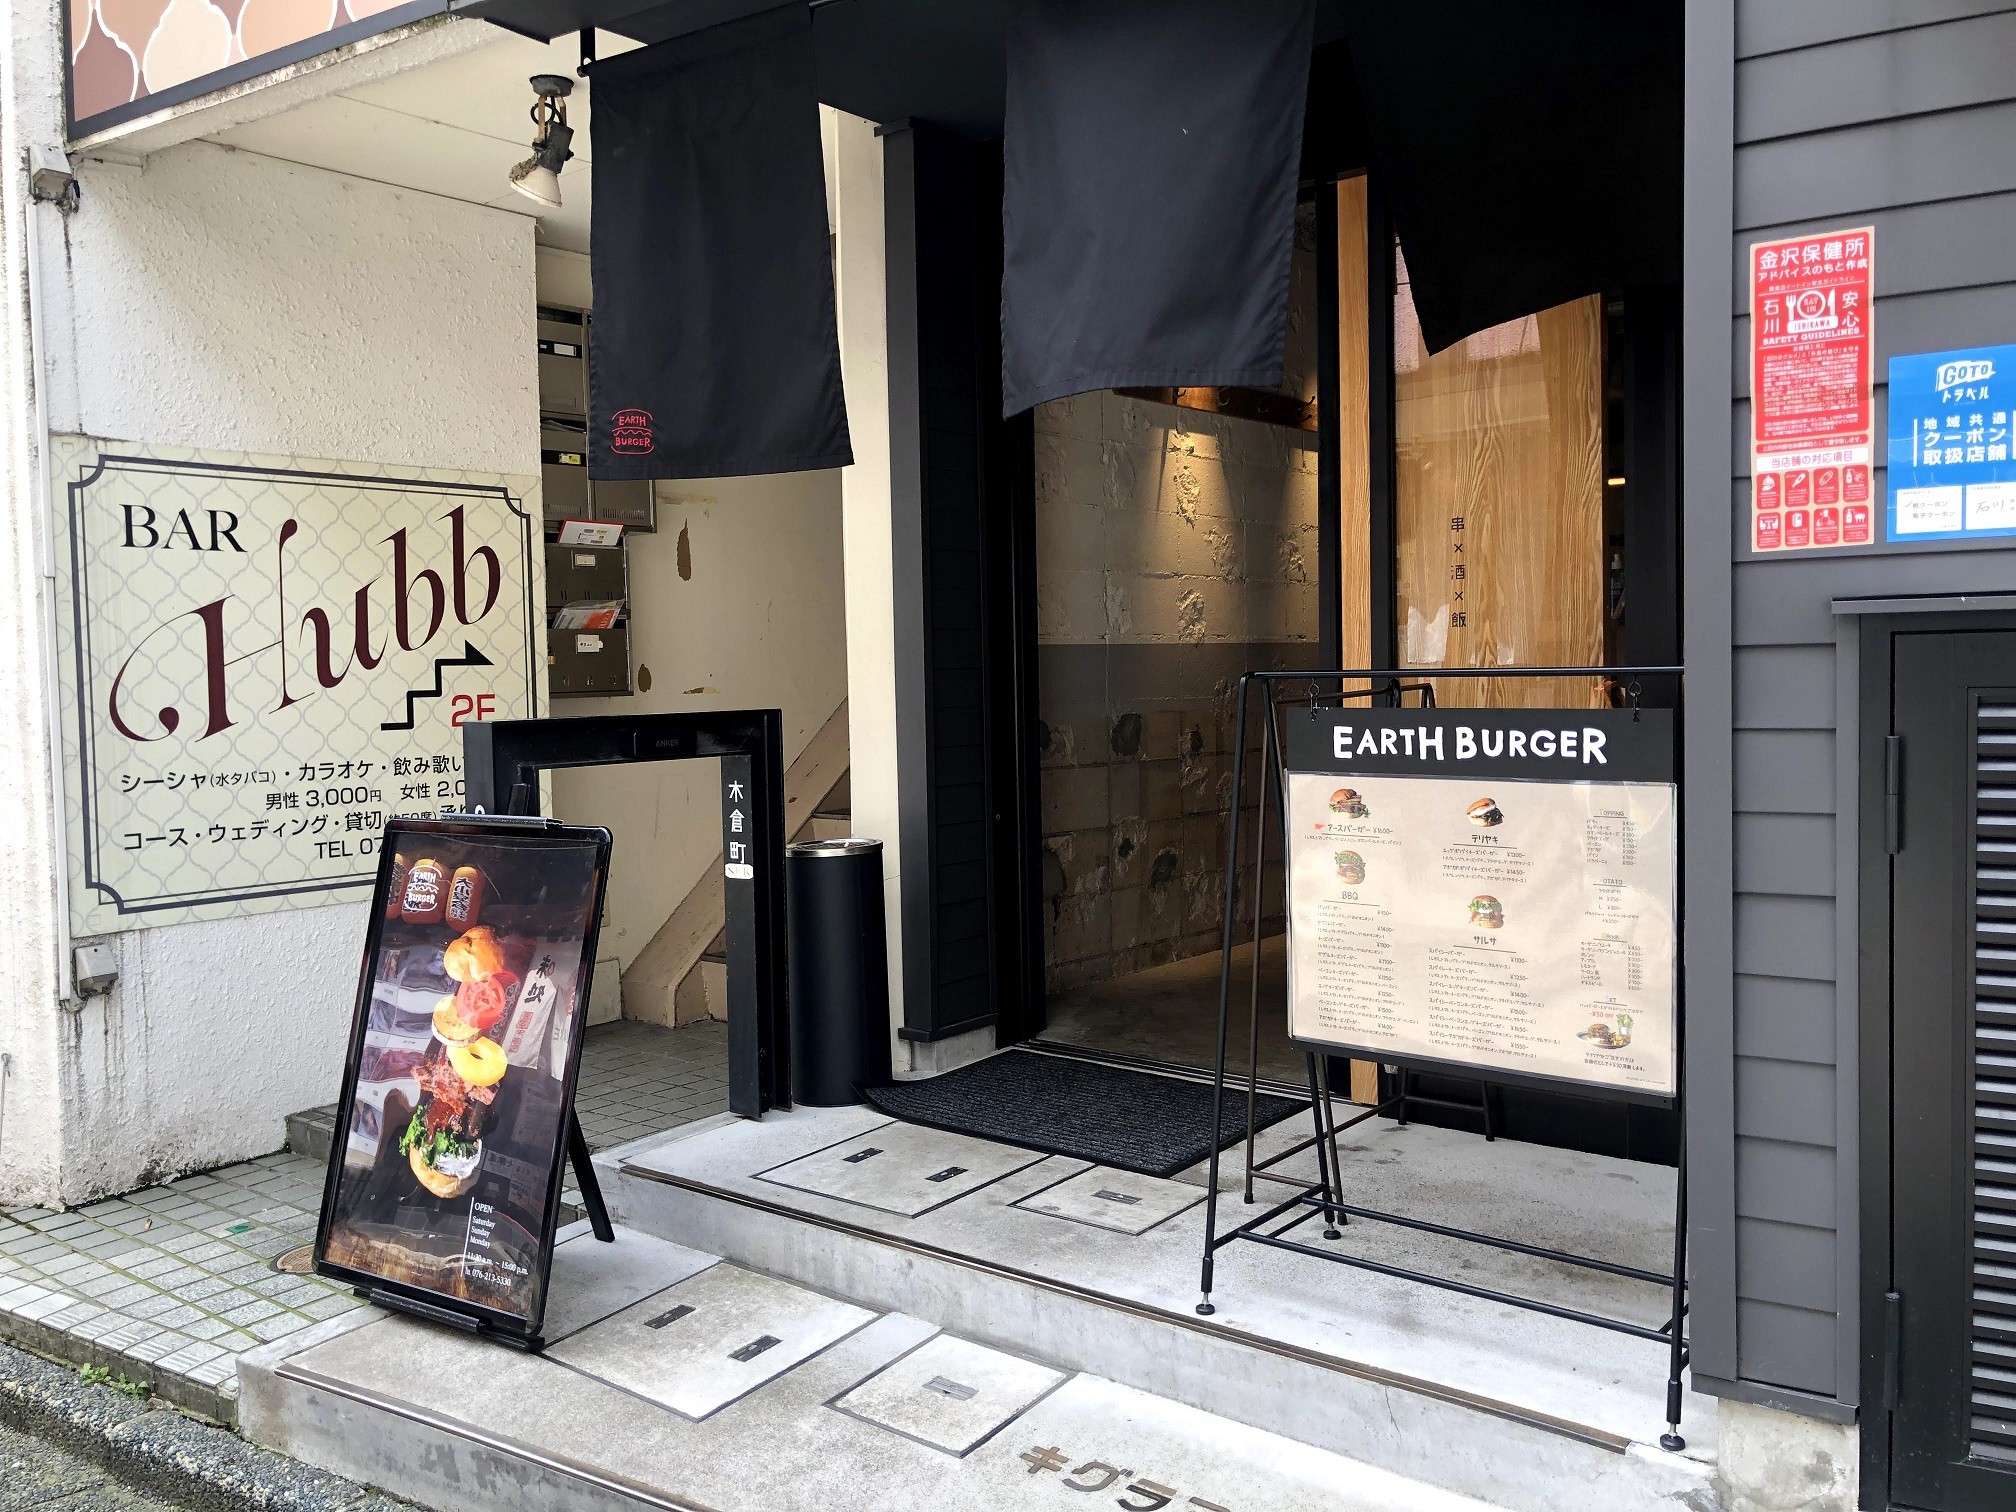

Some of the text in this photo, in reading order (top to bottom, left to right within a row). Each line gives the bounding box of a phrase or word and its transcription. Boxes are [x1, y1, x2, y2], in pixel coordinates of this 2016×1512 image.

[1760, 237, 1865, 270] 金沢保健所
[1758, 258, 1868, 283] アドバイスのもと作成
[1763, 298, 1780, 335] 石川
[1842, 290, 1860, 328] 安心
[1794, 320, 1831, 331] ISHIKAWA
[1763, 327, 1860, 346] SAFETY GUIDELINES
[1942, 386, 1989, 404] トラベル
[619, 416, 646, 426] EARTH
[1923, 411, 2007, 430] 地域共通
[615, 437, 651, 447] BURGER
[1923, 427, 2007, 448] クーポン
[1771, 451, 1853, 468] 当店舗の対応項目
[1923, 443, 2007, 466] 取扱店舗
[121, 503, 248, 553] BAR
[108, 503, 501, 743] Hubb
[451, 693, 496, 727] 2F
[655, 739, 679, 748] ANKER
[1333, 725, 1608, 764] EARTH BURGER
[266, 792, 300, 811] 男性
[305, 786, 382, 808] 3,000円
[400, 783, 431, 800] 女性
[728, 780, 747, 864] 木倉町
[1471, 834, 1499, 844] テリヤキ
[314, 840, 354, 860] TEL
[413, 871, 437, 883] EARTH
[407, 892, 436, 905] BURGER
[1341, 890, 1359, 900] BBQ
[1473, 935, 1497, 945] サルサ
[474, 1202, 494, 1214] OPEN
[472, 1216, 496, 1229] Saturday
[471, 1226, 491, 1238] Sunday
[469, 1235, 491, 1249] Monday
[501, 1260, 516, 1272] 15:00
[516, 1265, 529, 1275] p.m.
[1019, 1445, 1233, 1512] キグラ
